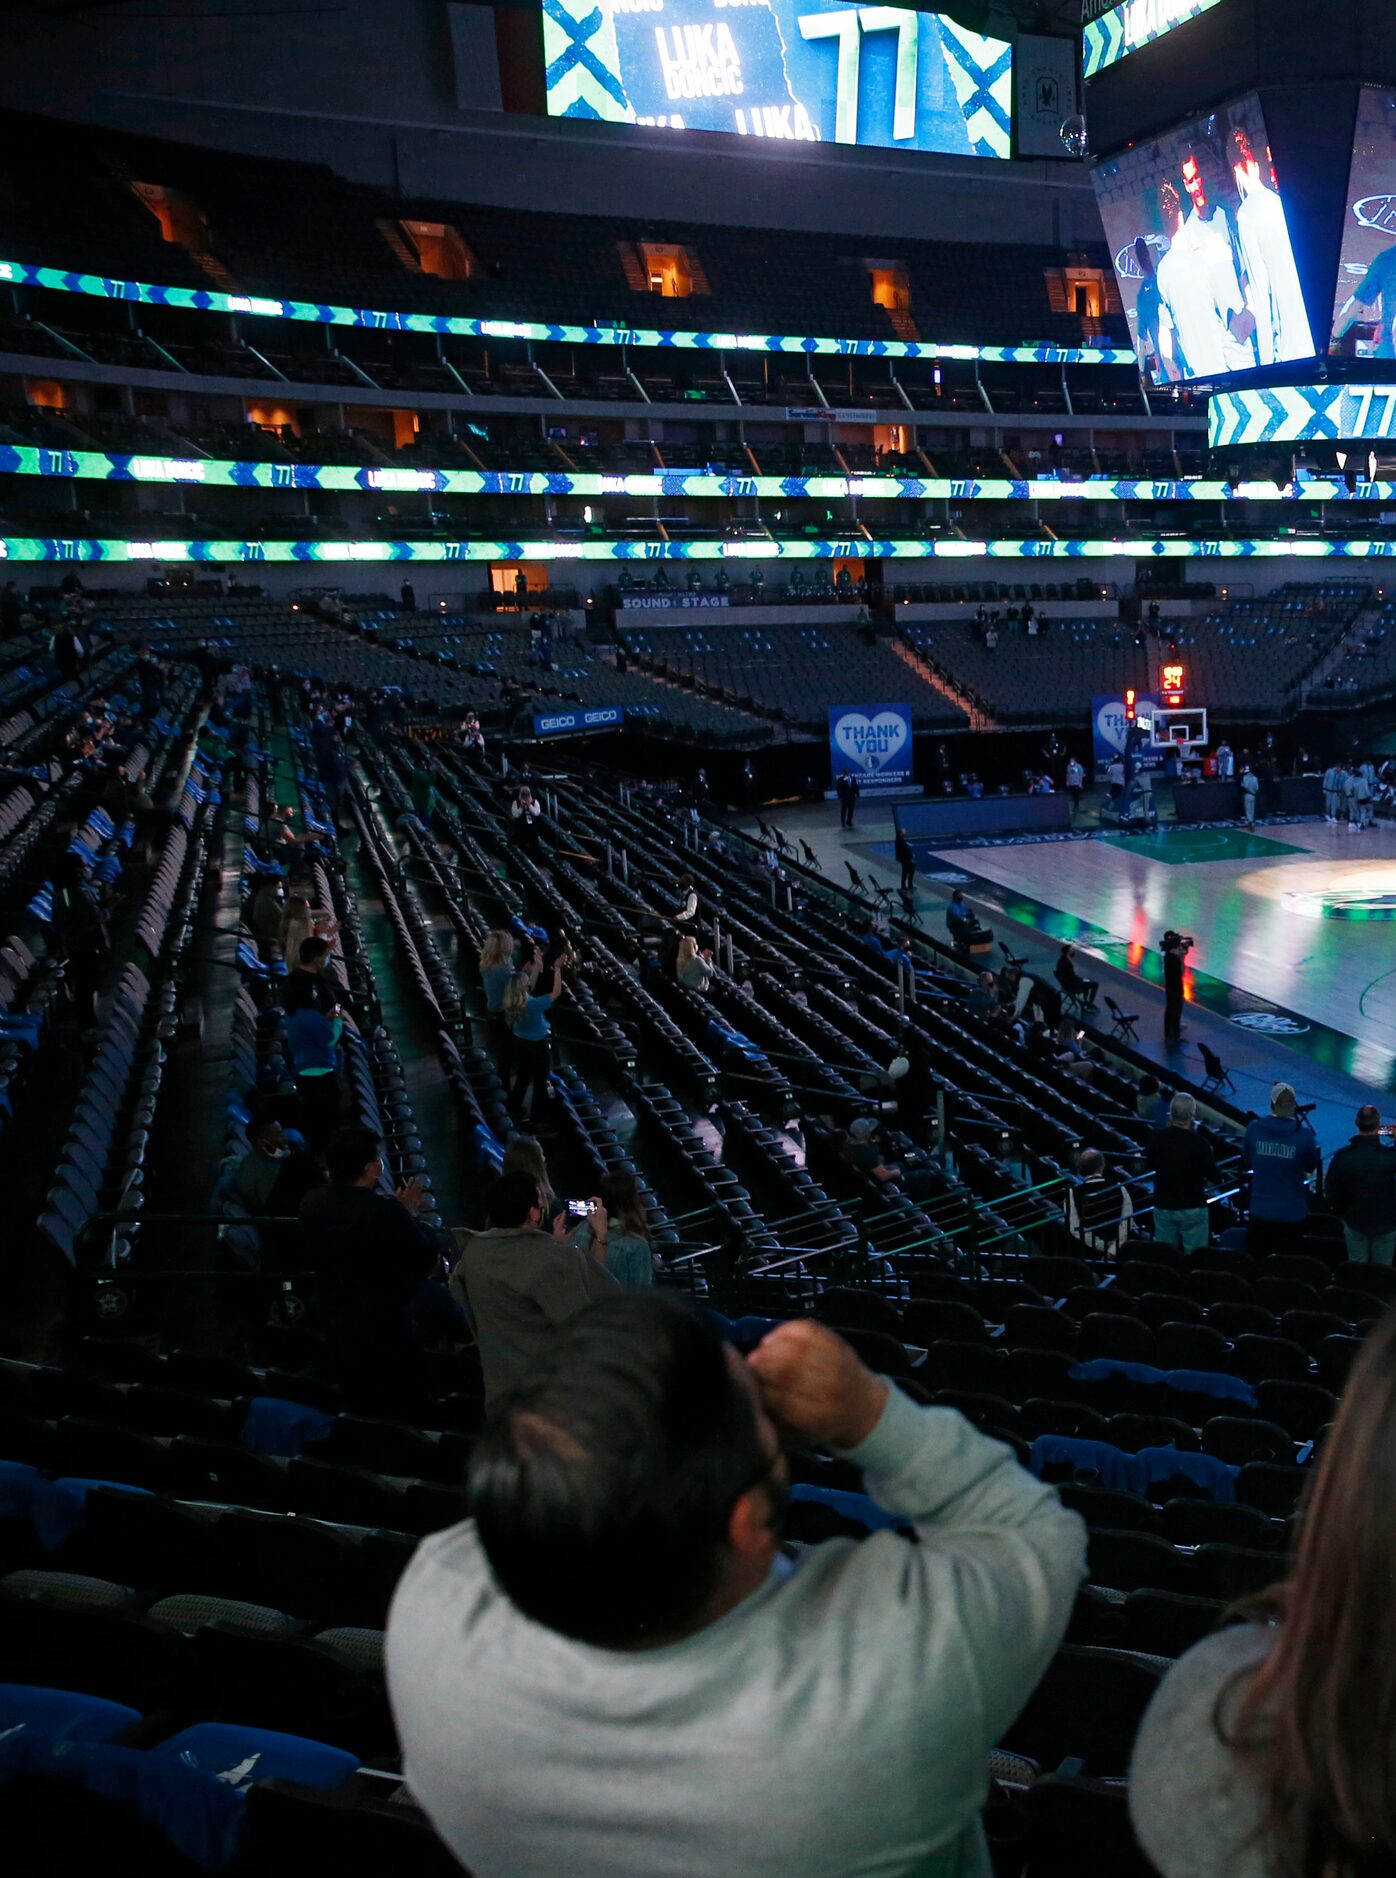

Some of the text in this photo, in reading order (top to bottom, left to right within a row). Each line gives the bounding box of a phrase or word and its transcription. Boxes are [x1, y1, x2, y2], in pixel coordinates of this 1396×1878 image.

[655, 23, 741, 67] LUKA
[664, 65, 745, 100] DONCIC
[798, 6, 918, 145] 77
[110, 280, 125, 298] 77
[372, 311, 387, 328] 77
[48, 451, 62, 472] 77
[275, 465, 290, 484] 77
[508, 474, 523, 491] 77
[736, 477, 752, 494] 77
[952, 481, 965, 496] 77
[1155, 482, 1169, 497] 77
[1357, 482, 1370, 497] 77
[62, 541, 73, 558] 77
[447, 543, 460, 558] 77
[623, 597, 729, 609] SOUND STAGE
[1164, 676, 1180, 689] 24
[541, 710, 617, 730] GEICO GEICO
[842, 725, 899, 740] THANK
[854, 739, 888, 753] YOU
